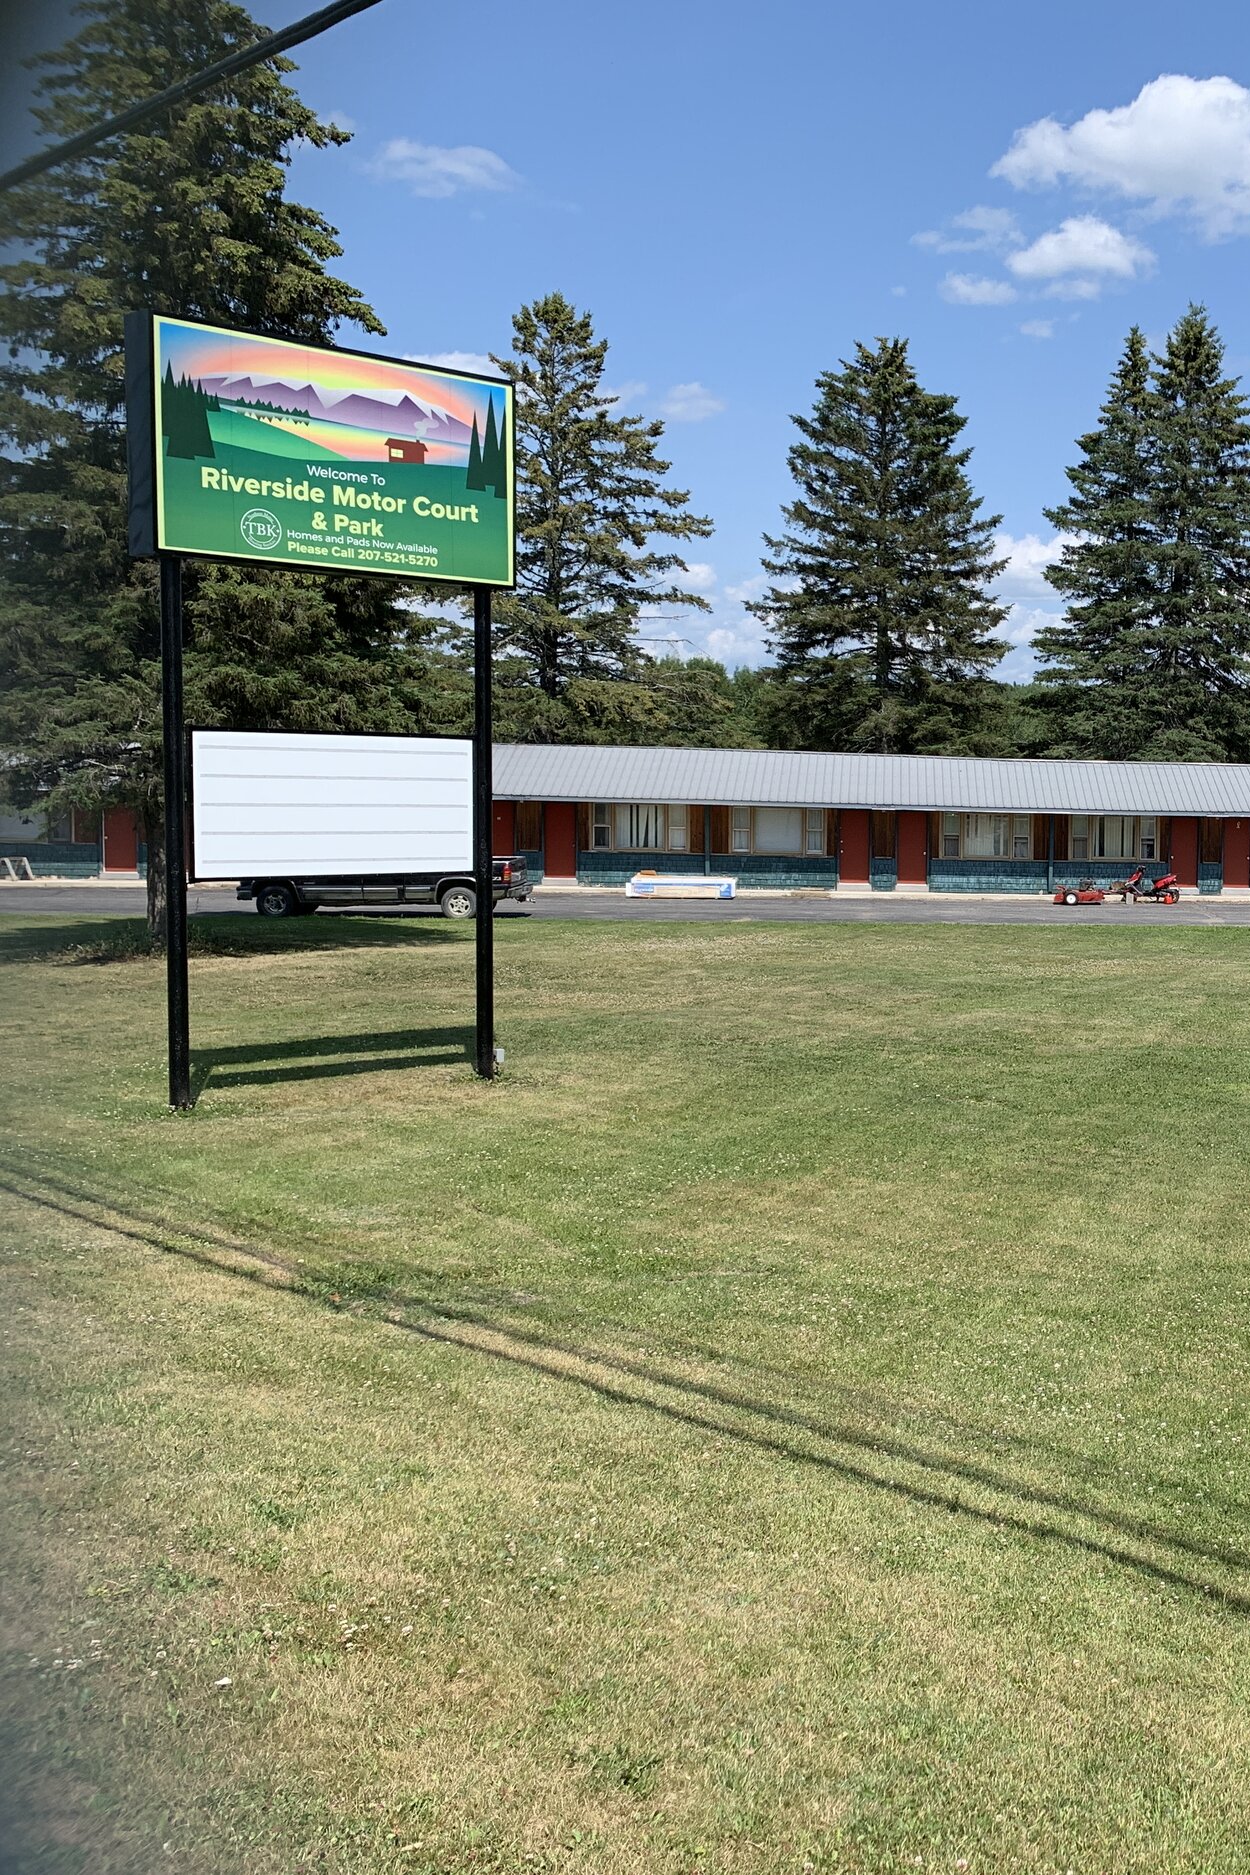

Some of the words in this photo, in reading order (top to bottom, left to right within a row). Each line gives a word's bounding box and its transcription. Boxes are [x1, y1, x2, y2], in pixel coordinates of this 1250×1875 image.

[307, 464, 368, 483] Welcome
[371, 474, 385, 486] To
[201, 467, 325, 503] Riverside
[333, 485, 406, 513] Motor
[413, 496, 479, 522] Court
[245, 522, 278, 537] TBK
[312, 512, 327, 531] &
[334, 514, 384, 537] Park
[287, 530, 323, 542] Homes
[326, 534, 344, 544] and
[347, 536, 370, 547] Pads
[372, 539, 394, 549] Now
[396, 542, 438, 554] Available
[288, 541, 328, 556] Please
[332, 547, 354, 558] Call
[358, 549, 438, 567] 207-521-5270
